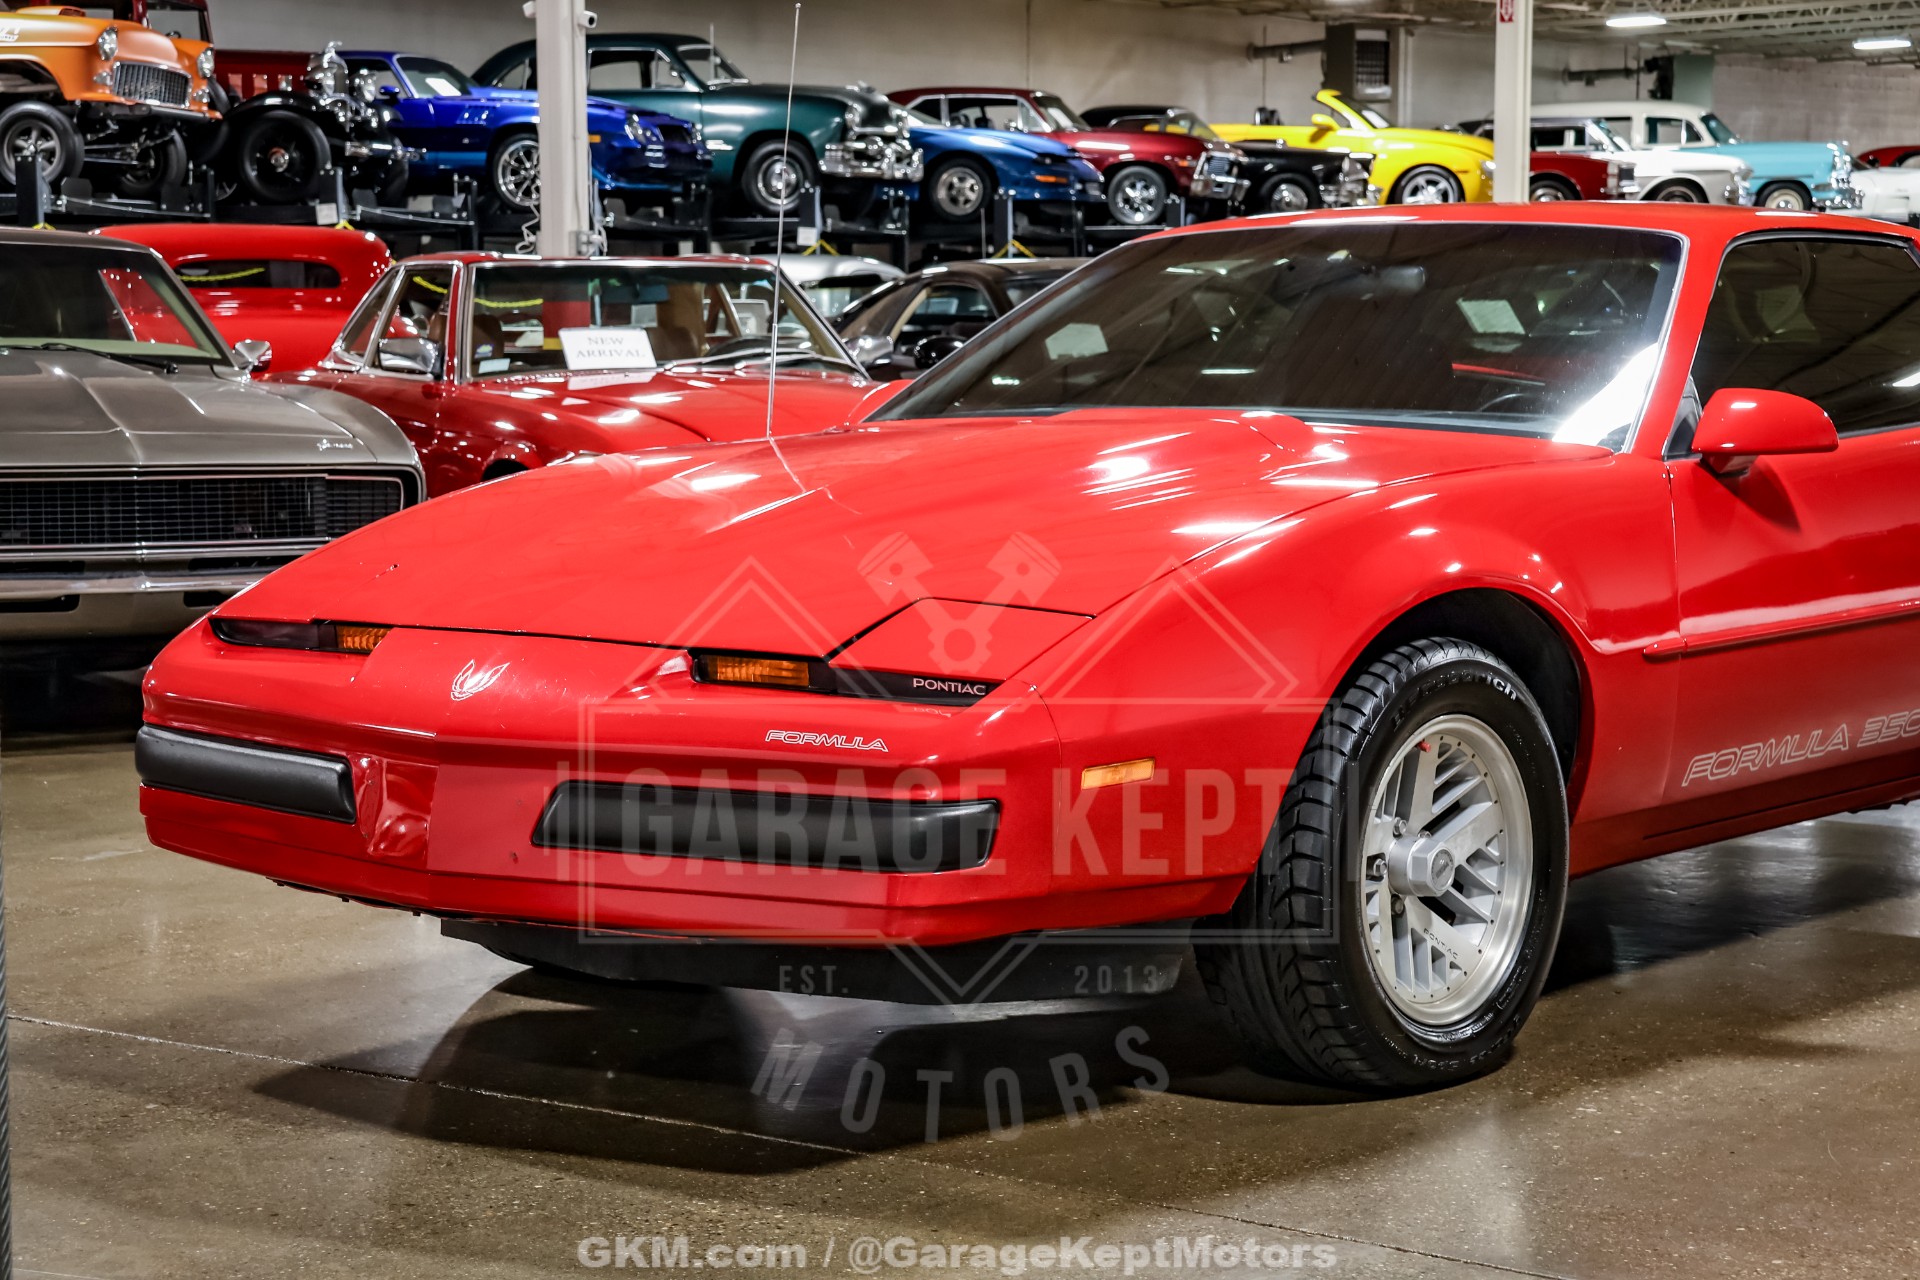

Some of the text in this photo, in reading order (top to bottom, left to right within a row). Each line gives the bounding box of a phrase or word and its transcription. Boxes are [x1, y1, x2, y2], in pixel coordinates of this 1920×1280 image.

[588, 336, 624, 346] NEW
[576, 349, 645, 359] ARRIVAL
[912, 677, 987, 696] PONTIAC
[765, 729, 889, 752] FORMULA
[1681, 723, 1849, 787] FORMULA
[1423, 927, 1459, 960] PONTIAC
